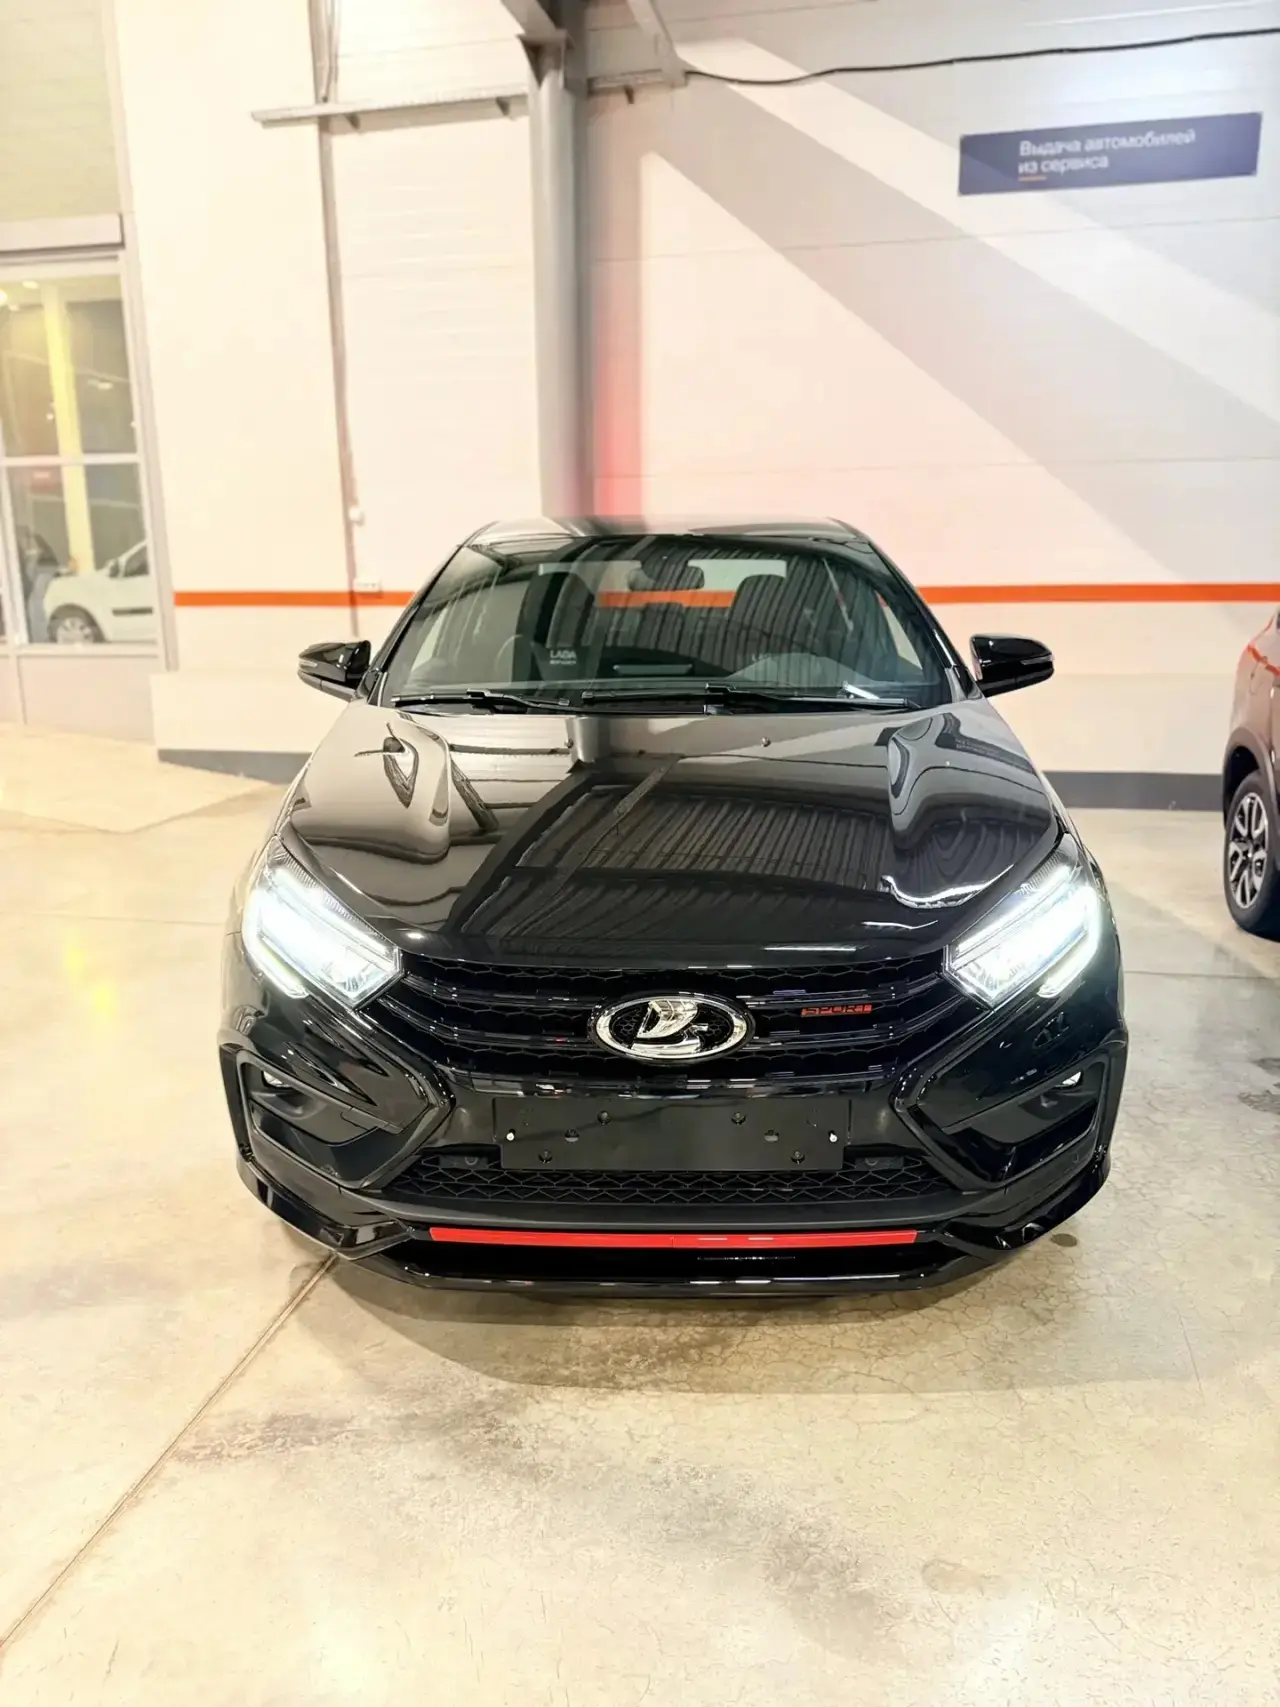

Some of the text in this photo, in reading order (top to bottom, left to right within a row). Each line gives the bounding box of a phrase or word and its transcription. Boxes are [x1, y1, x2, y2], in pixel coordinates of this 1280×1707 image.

[1019, 128, 1196, 157] Выдача автомобилей
[1018, 155, 1109, 176] из сервиса
